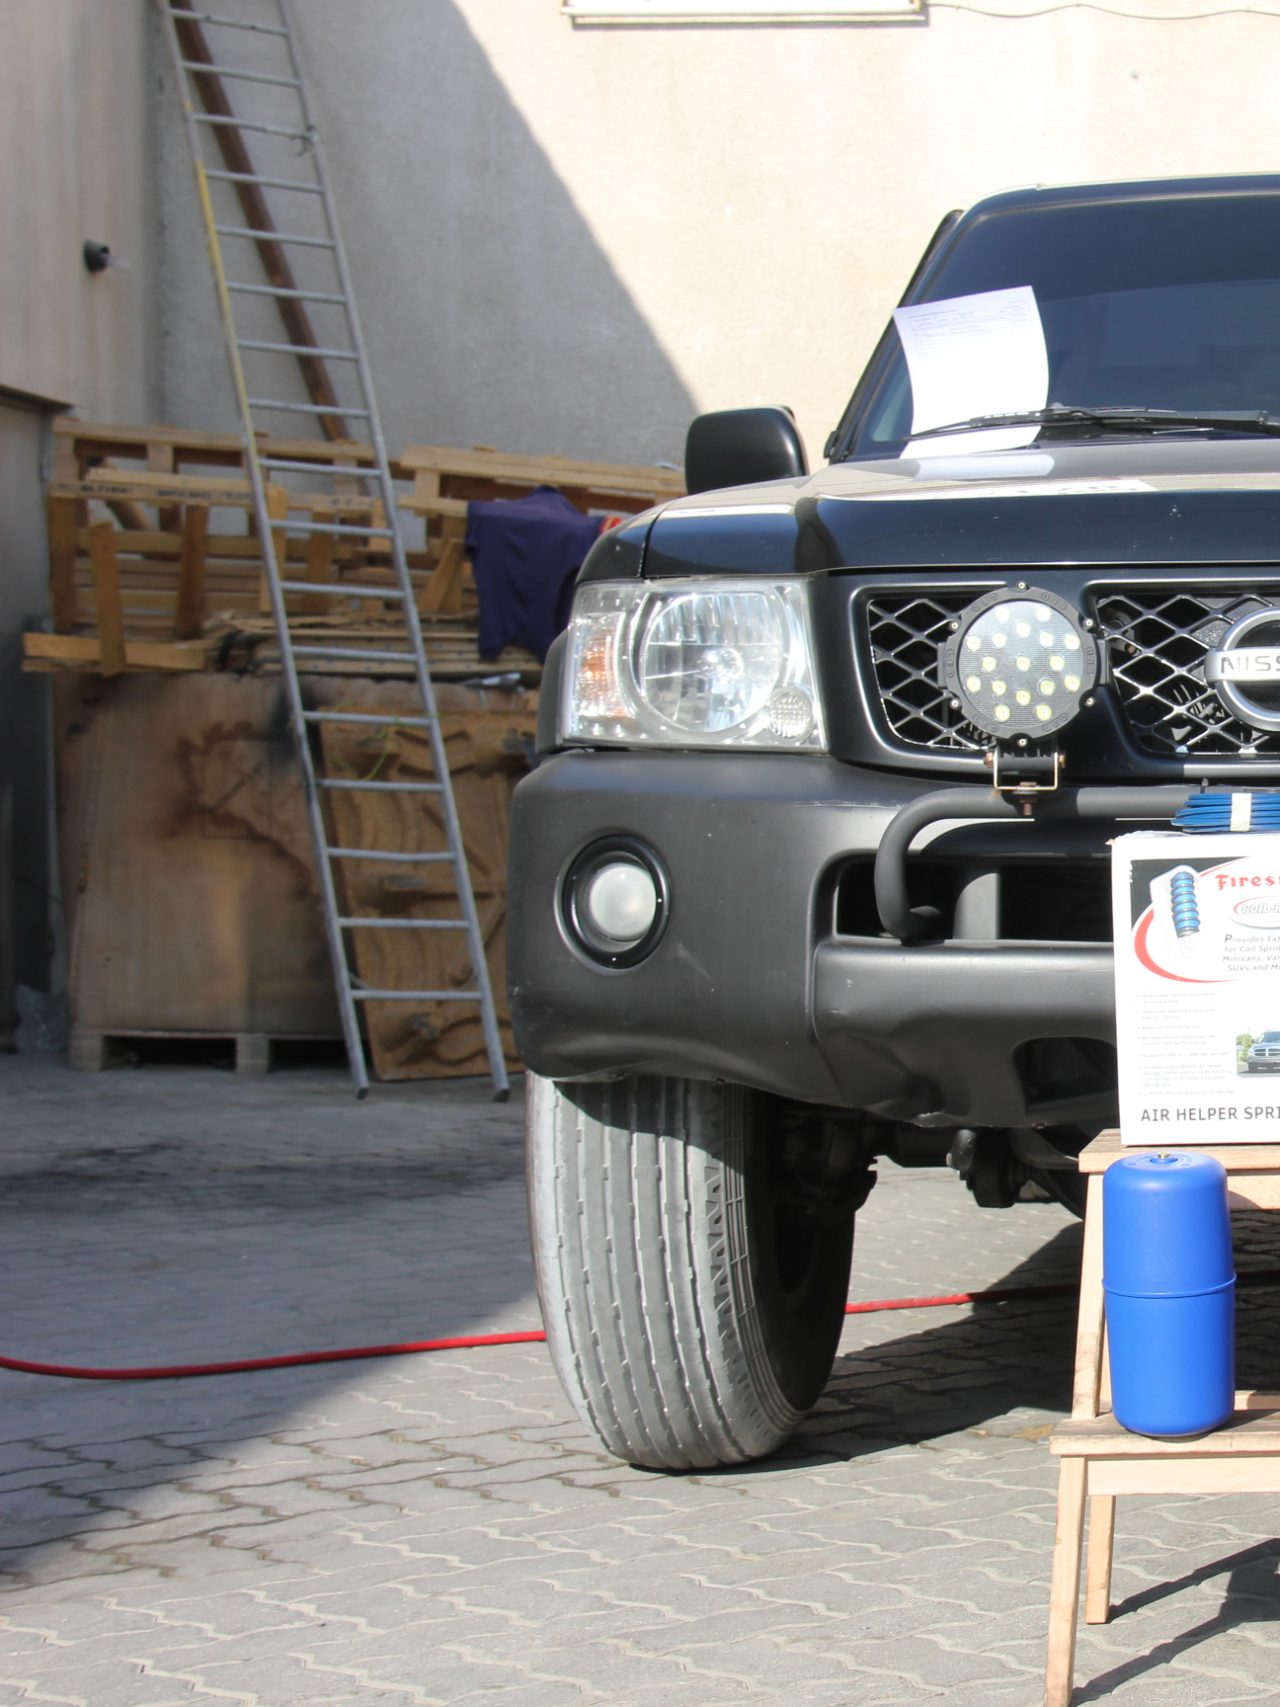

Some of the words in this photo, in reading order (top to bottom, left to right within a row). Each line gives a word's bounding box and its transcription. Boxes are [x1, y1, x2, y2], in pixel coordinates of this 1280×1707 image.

[1223, 933, 1264, 944] Provides
[1223, 945, 1238, 953] for
[1238, 945, 1256, 953] Coil
[1140, 1108, 1171, 1122] AIR
[1176, 1107, 1239, 1121] HELPER
